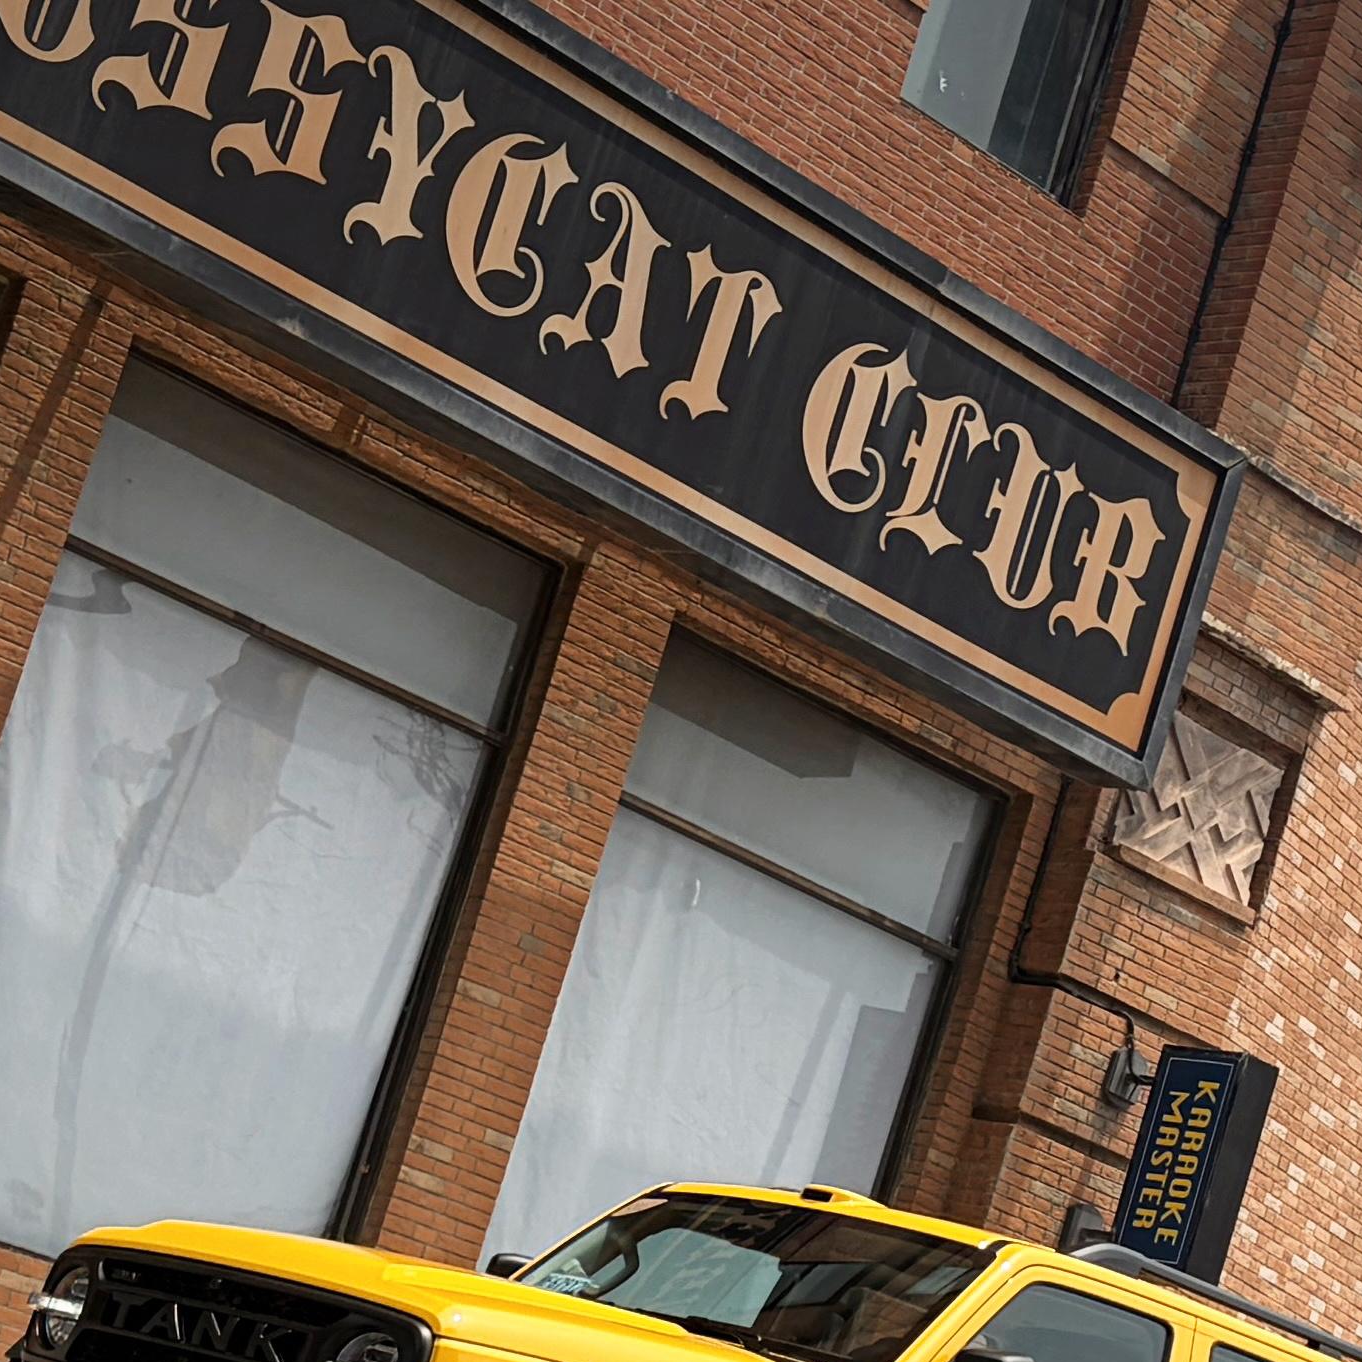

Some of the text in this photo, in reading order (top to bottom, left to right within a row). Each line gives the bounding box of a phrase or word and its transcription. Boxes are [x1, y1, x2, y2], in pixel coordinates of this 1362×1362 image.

[801, 342, 1169, 657] CLUB
[1132, 1091, 1190, 1230] MASTER
[1153, 1080, 1221, 1247] KARAOKE
